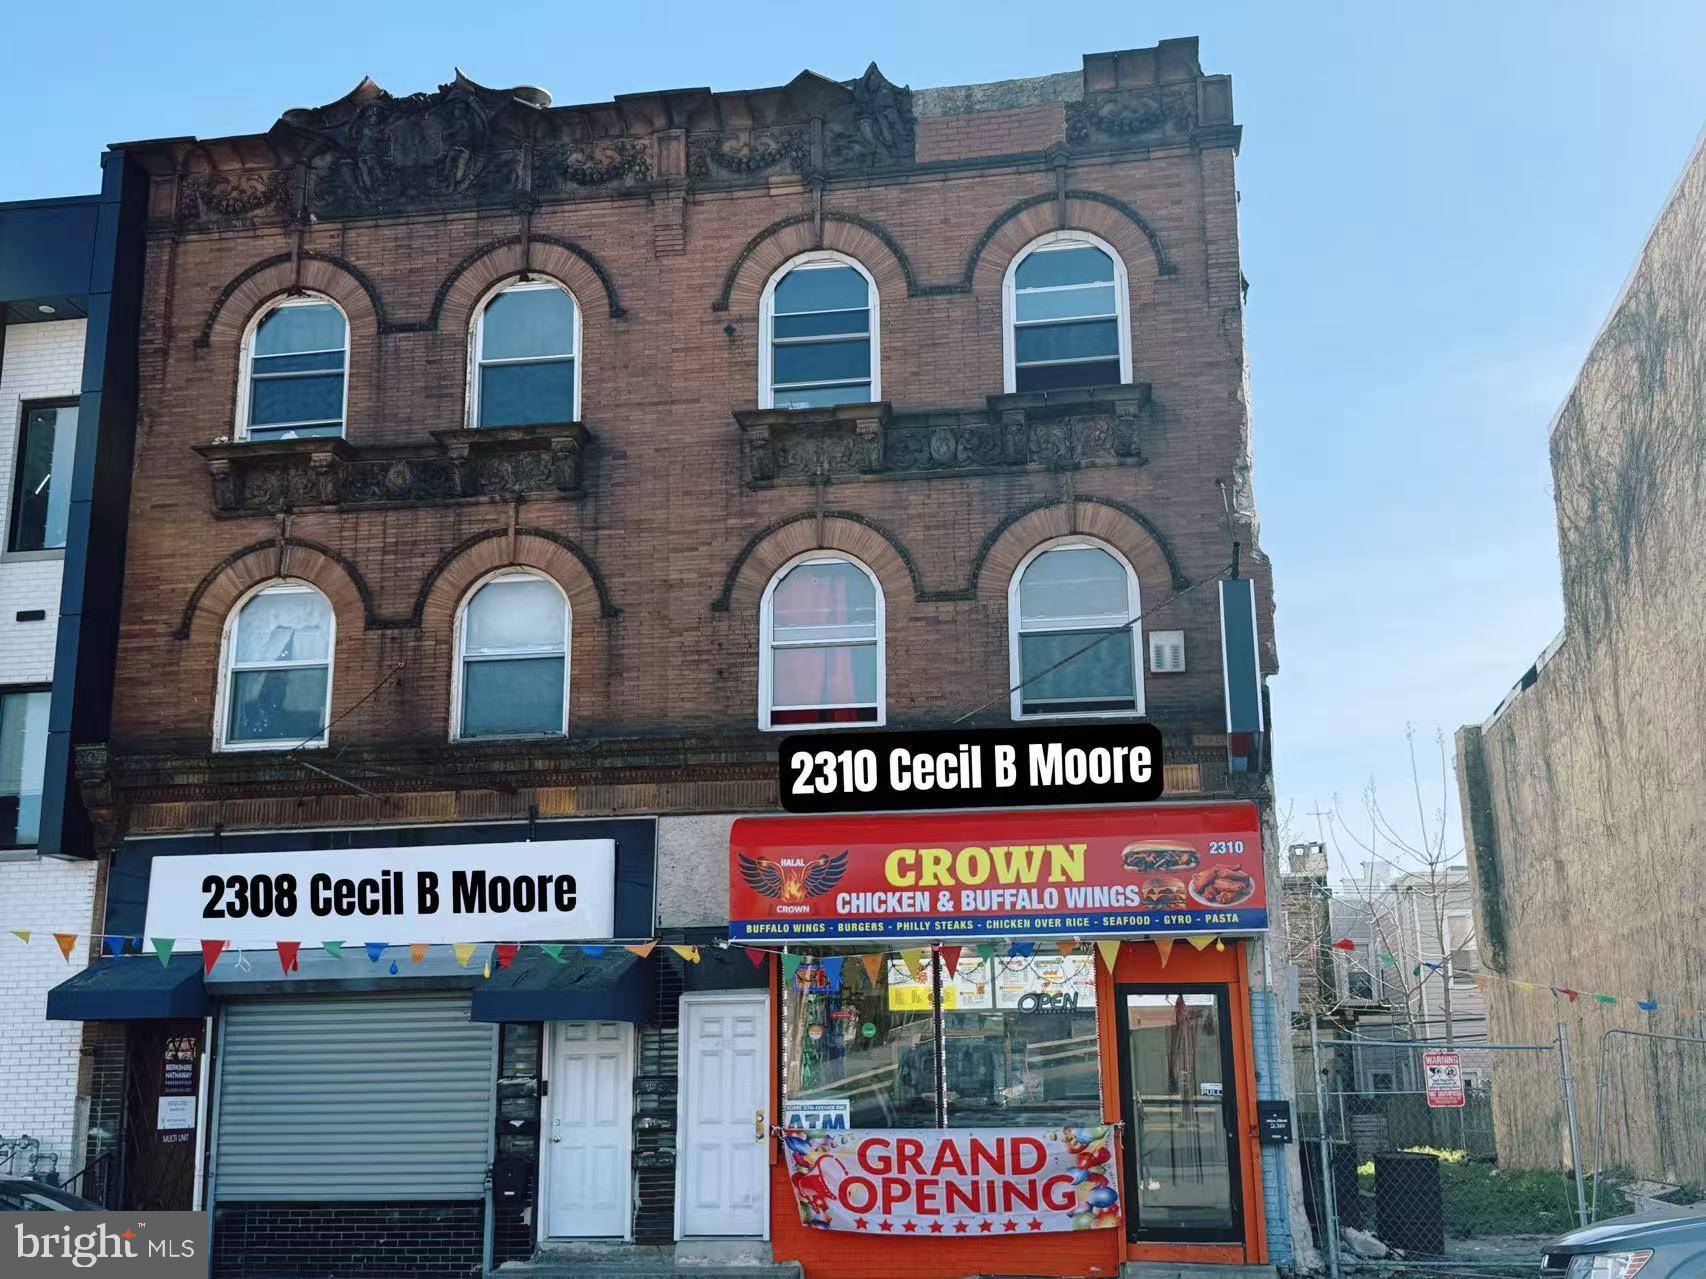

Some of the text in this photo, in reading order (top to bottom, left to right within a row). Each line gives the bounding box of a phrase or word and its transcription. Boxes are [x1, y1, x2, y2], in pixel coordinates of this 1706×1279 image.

[1209, 840, 1244, 854] 2310
[780, 858, 806, 868] HALAL
[884, 843, 1088, 888] CROWN
[776, 904, 810, 914] CROWN
[836, 884, 1141, 915] CHICKEN & BUFFALO WINGS
[746, 913, 1239, 934] BUFFALO WINGS BURGERS PHILLY STEAKS CHICKEN OVER RICE SEAFOOD GYRO PASTA
[1017, 991, 1079, 1013] OPEN
[1425, 1054, 1459, 1065] WARNING
[788, 1113, 846, 1129] ATM
[857, 1136, 1048, 1177] GRAND
[838, 1173, 1077, 1216] OPENING
